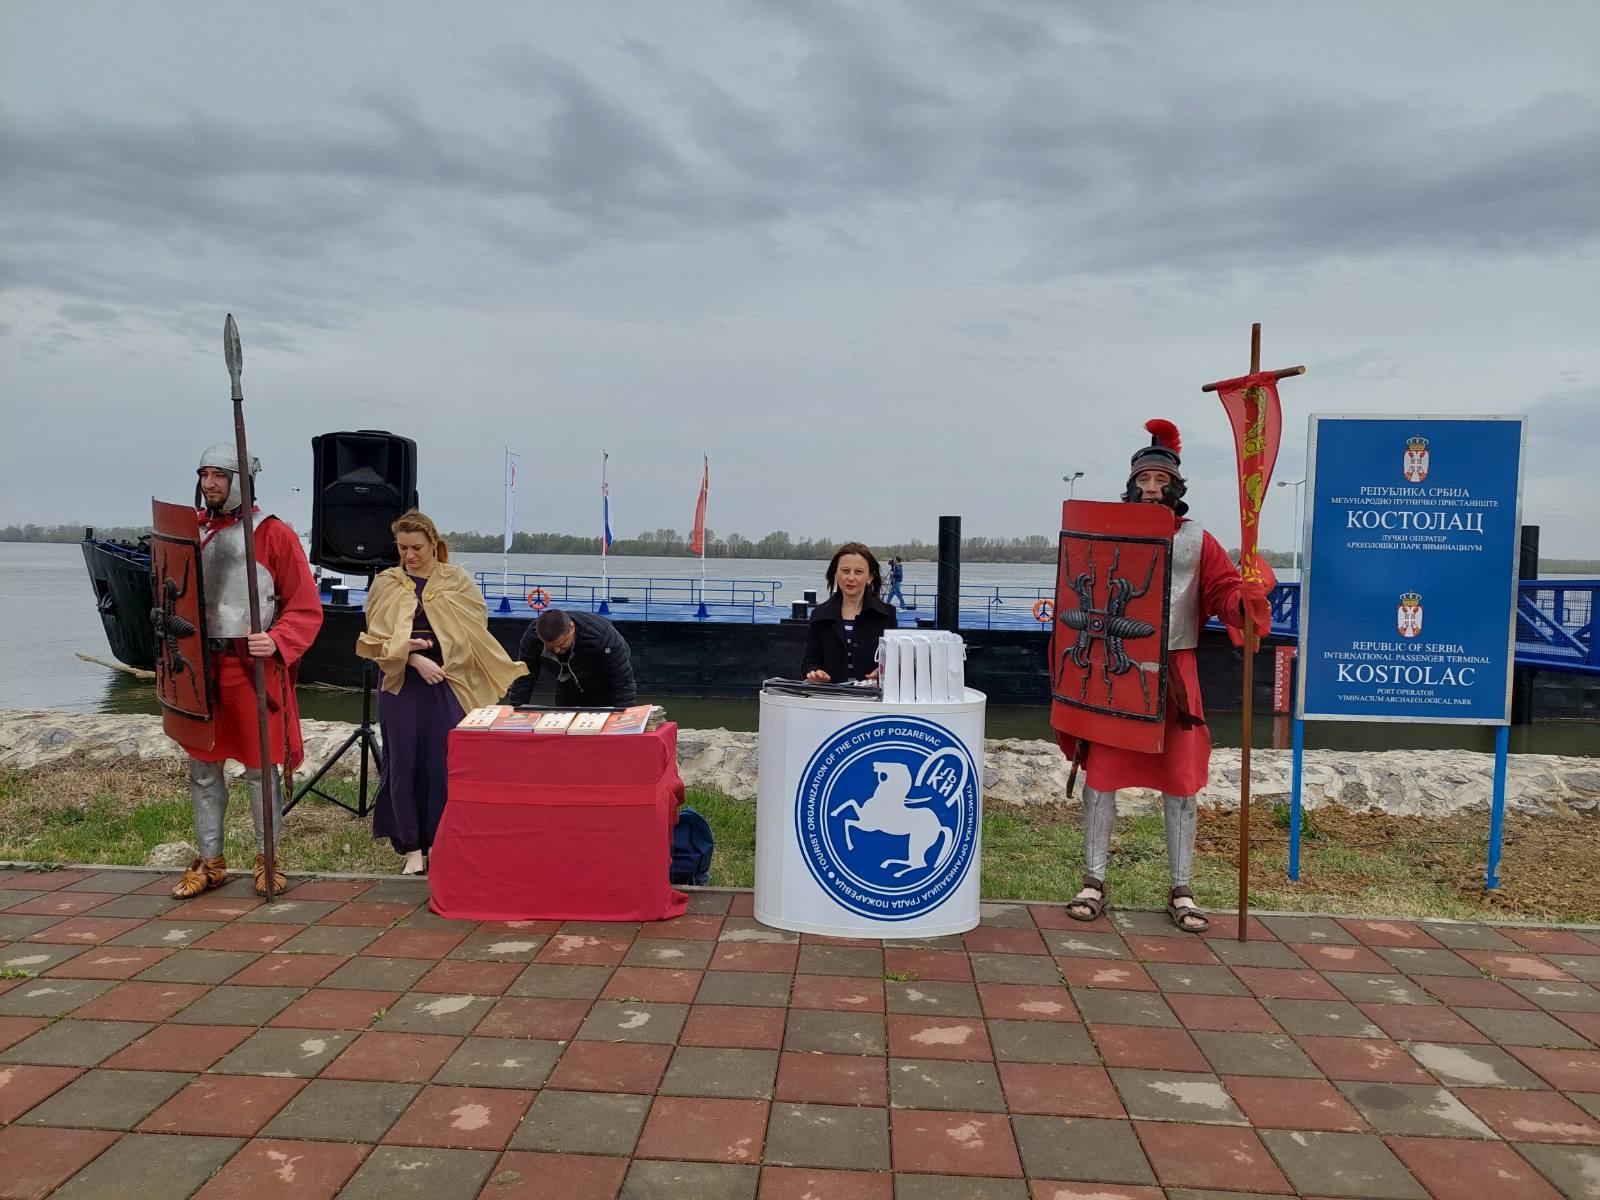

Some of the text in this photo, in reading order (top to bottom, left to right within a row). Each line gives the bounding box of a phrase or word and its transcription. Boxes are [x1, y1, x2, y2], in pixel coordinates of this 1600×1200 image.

[1360, 487, 1469, 497] РЕПУБЛИКА СРБИЈА
[1331, 497, 1499, 507] МЕЂУНАРОДНО ПУТНИЧКО ПРИСТАНИШТЕ
[1347, 511, 1484, 534] КОСТОЛАЦ
[1352, 642, 1464, 653] REPUBLIC OF SERBIA
[1324, 652, 1394, 660] INTERNATIONAL
[1396, 654, 1445, 662] PASSENGER
[1336, 664, 1475, 686] KOSTOLAC
[852, 732, 871, 745] CITY
[888, 728, 941, 747] POZAREVAC
[835, 742, 851, 756] THE
[826, 755, 835, 765] OF
[808, 765, 827, 829] ORGANIZATION
[808, 833, 828, 871] TOURIST
[835, 784, 973, 908] ТУРИСТИЧКА ОРГАНИЗАЦИЈА ГРАДА ПОЖАРЕВЦА
